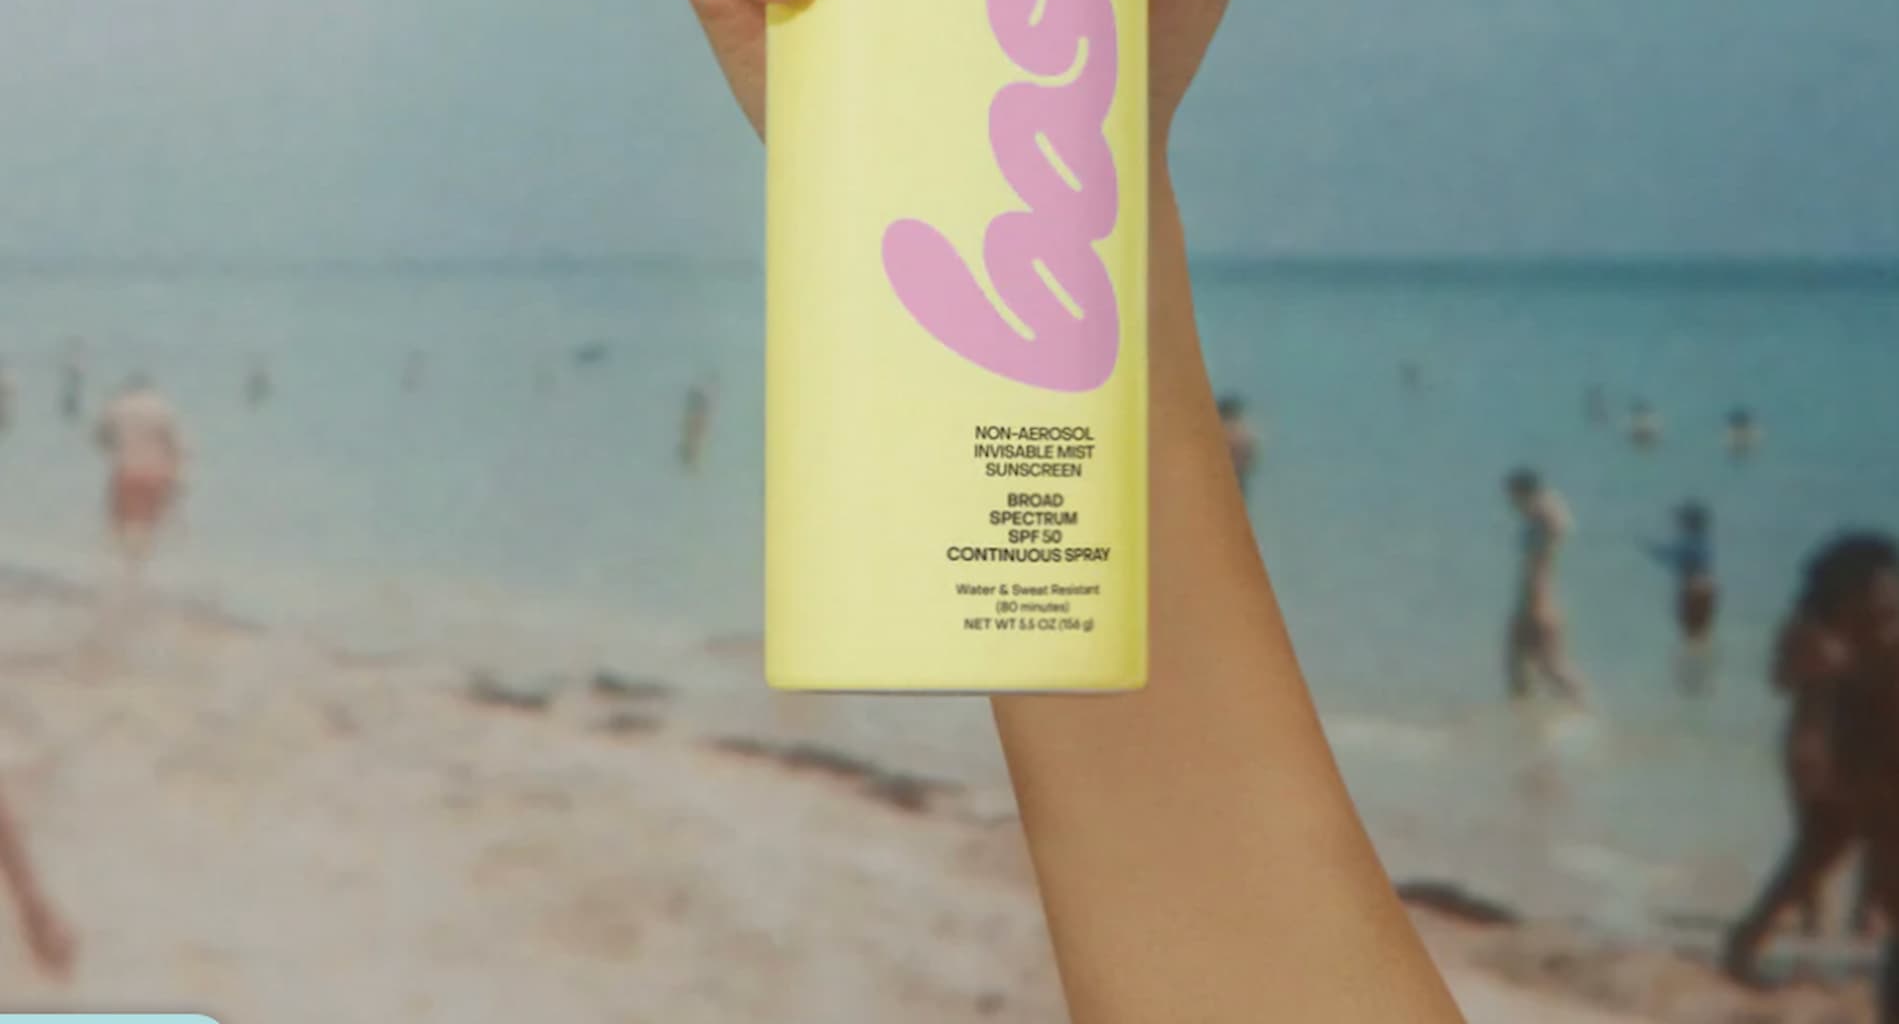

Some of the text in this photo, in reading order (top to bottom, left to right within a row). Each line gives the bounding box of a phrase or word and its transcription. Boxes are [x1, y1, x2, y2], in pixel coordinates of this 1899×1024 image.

[975, 425, 1095, 442] NON-AEROSOL
[974, 443, 1096, 460] INVISABLE MIST
[985, 461, 1083, 478] SUNSCREEN
[1007, 492, 1065, 508] BROAD
[988, 510, 1079, 526] SPECTRUM
[1008, 528, 1063, 544] SPF 50
[946, 546, 1111, 563] CONTINUOUS SPRAY
[956, 583, 1101, 596] Water & Sweat Resistant
[995, 600, 1069, 614] (80 minutes)
[964, 618, 1095, 633] NET WT 5.5 OZ (156 g)
